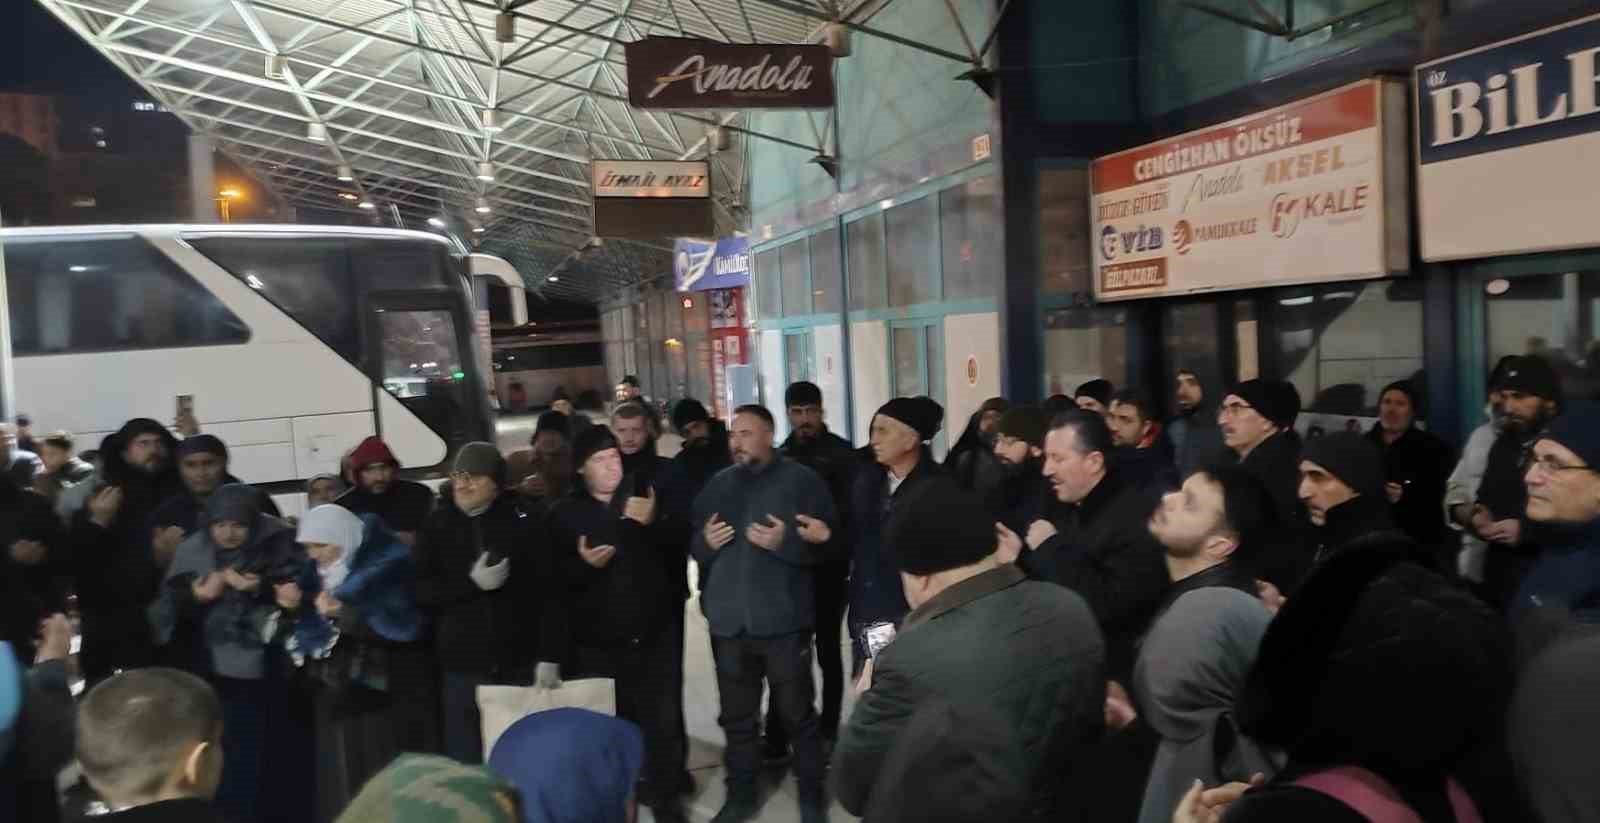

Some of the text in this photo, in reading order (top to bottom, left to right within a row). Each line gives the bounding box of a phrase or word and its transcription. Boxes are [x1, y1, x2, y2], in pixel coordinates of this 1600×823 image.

[648, 54, 814, 98] Anadolu
[1133, 113, 1303, 181] CENGİZHAN ÖKSÜZ
[1263, 144, 1345, 186] AKSEL
[1303, 184, 1369, 219] KALE
